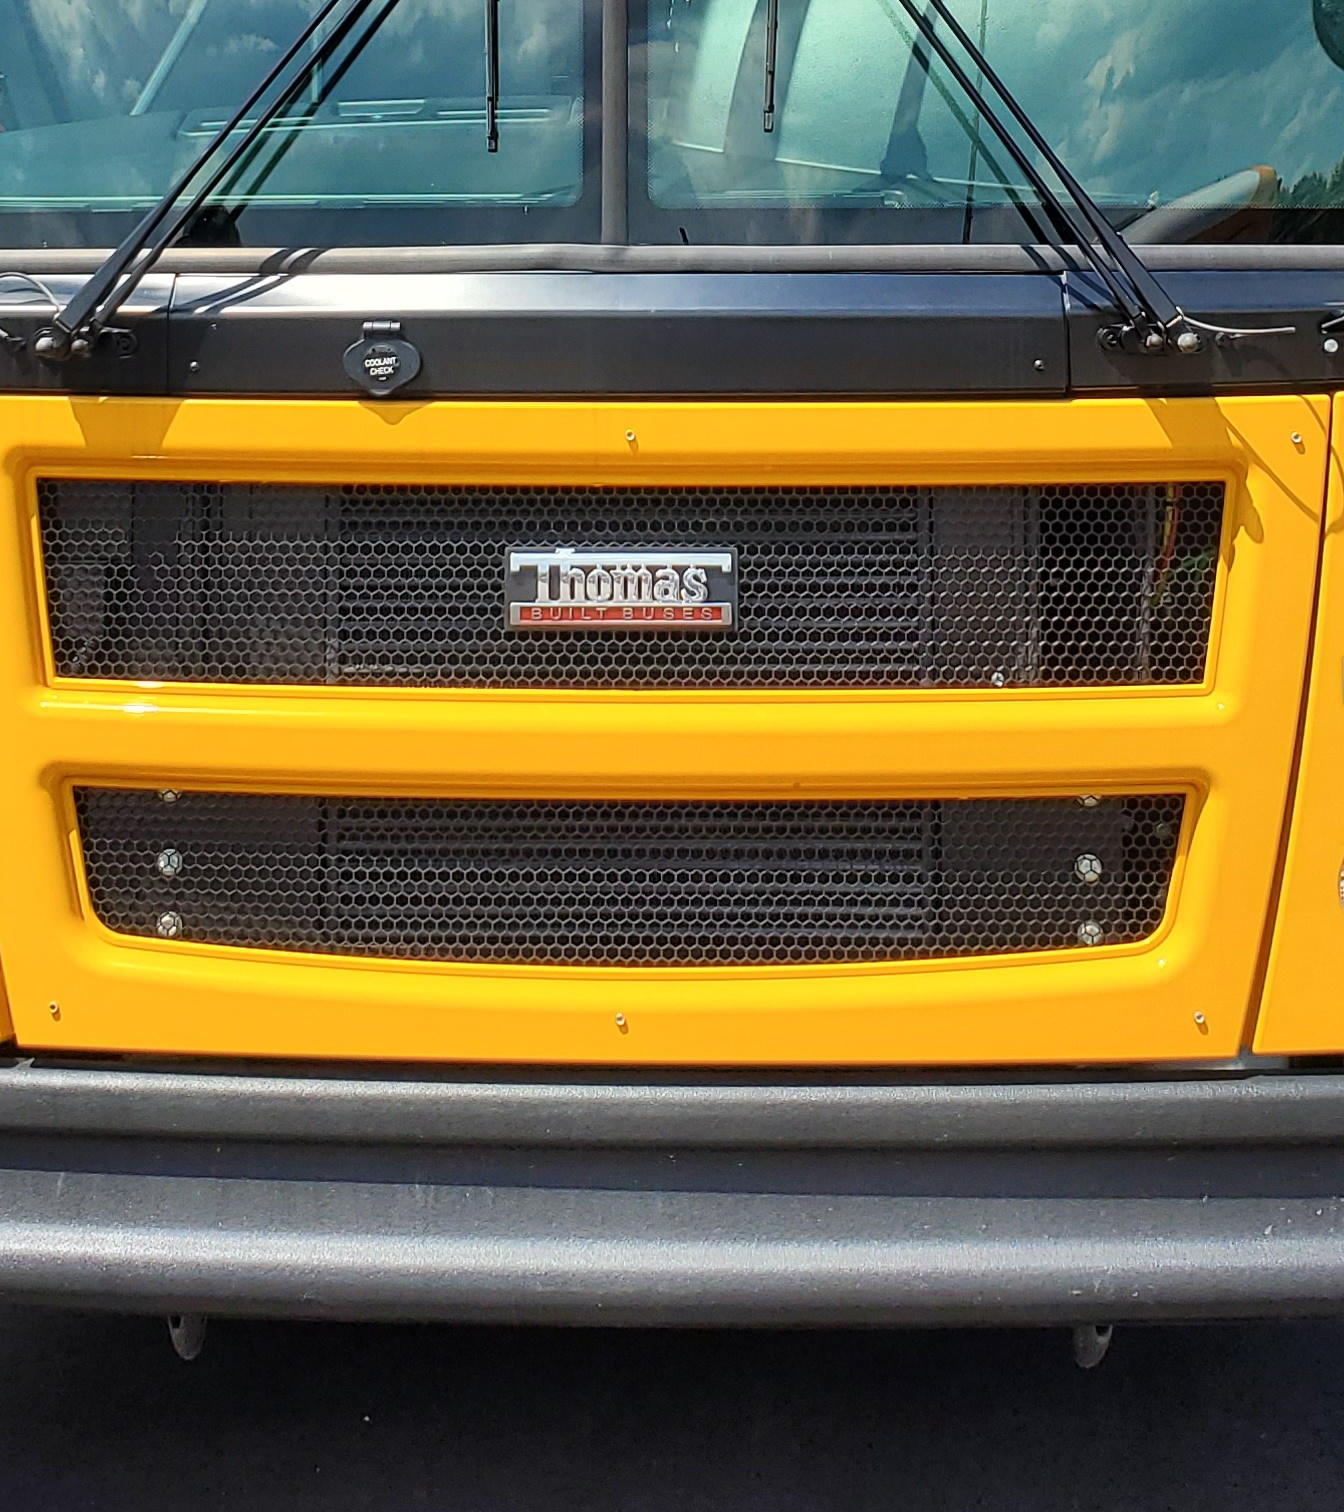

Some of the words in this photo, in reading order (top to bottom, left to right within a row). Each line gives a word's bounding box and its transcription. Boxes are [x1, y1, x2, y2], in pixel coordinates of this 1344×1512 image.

[364, 357, 397, 367] COOLANT
[370, 366, 394, 375] CHECK
[511, 548, 732, 604] Thomas
[531, 607, 607, 620] BUILT
[623, 607, 714, 620] BUSES
